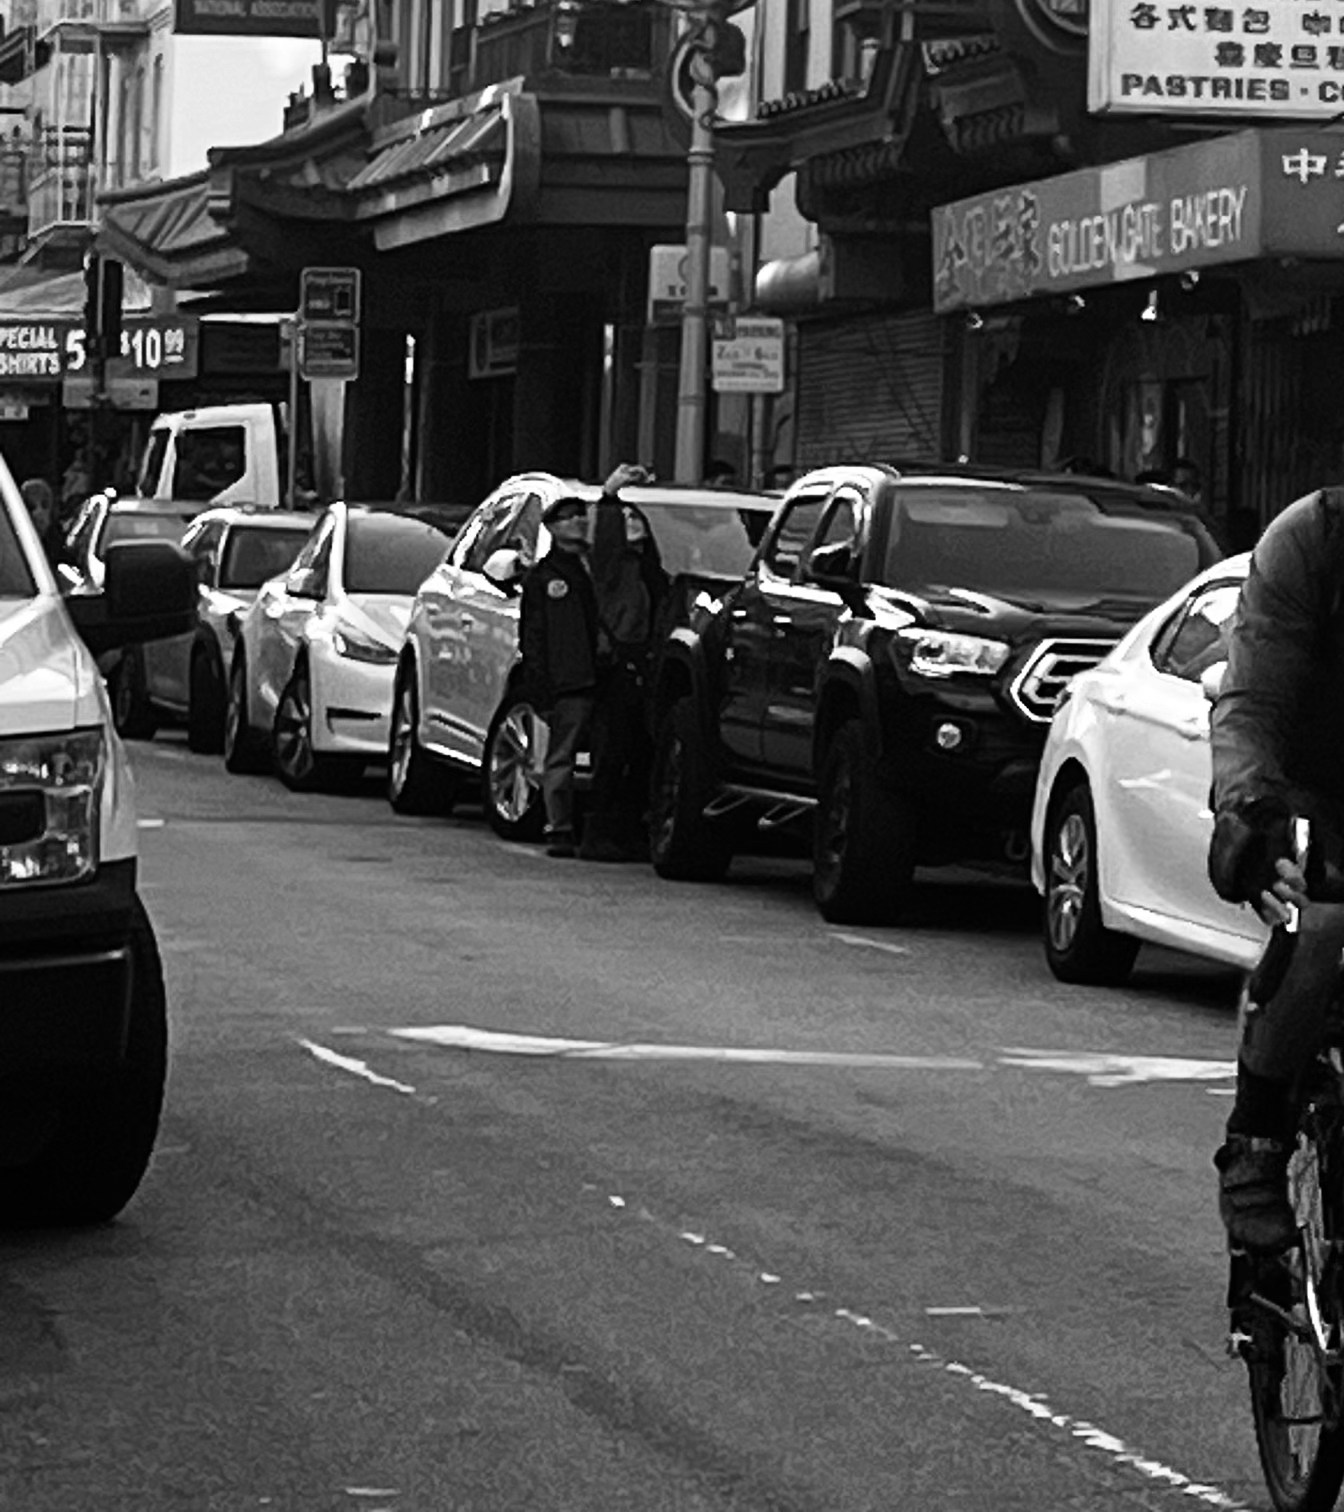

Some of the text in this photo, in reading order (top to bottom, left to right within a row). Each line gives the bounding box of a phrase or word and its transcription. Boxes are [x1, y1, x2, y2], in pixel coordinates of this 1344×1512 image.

[1121, 73, 1290, 101] PASTRIES
[1050, 215, 1119, 277] GOLDEN
[1169, 186, 1248, 255] BAKERY
[66, 329, 88, 370] 5
